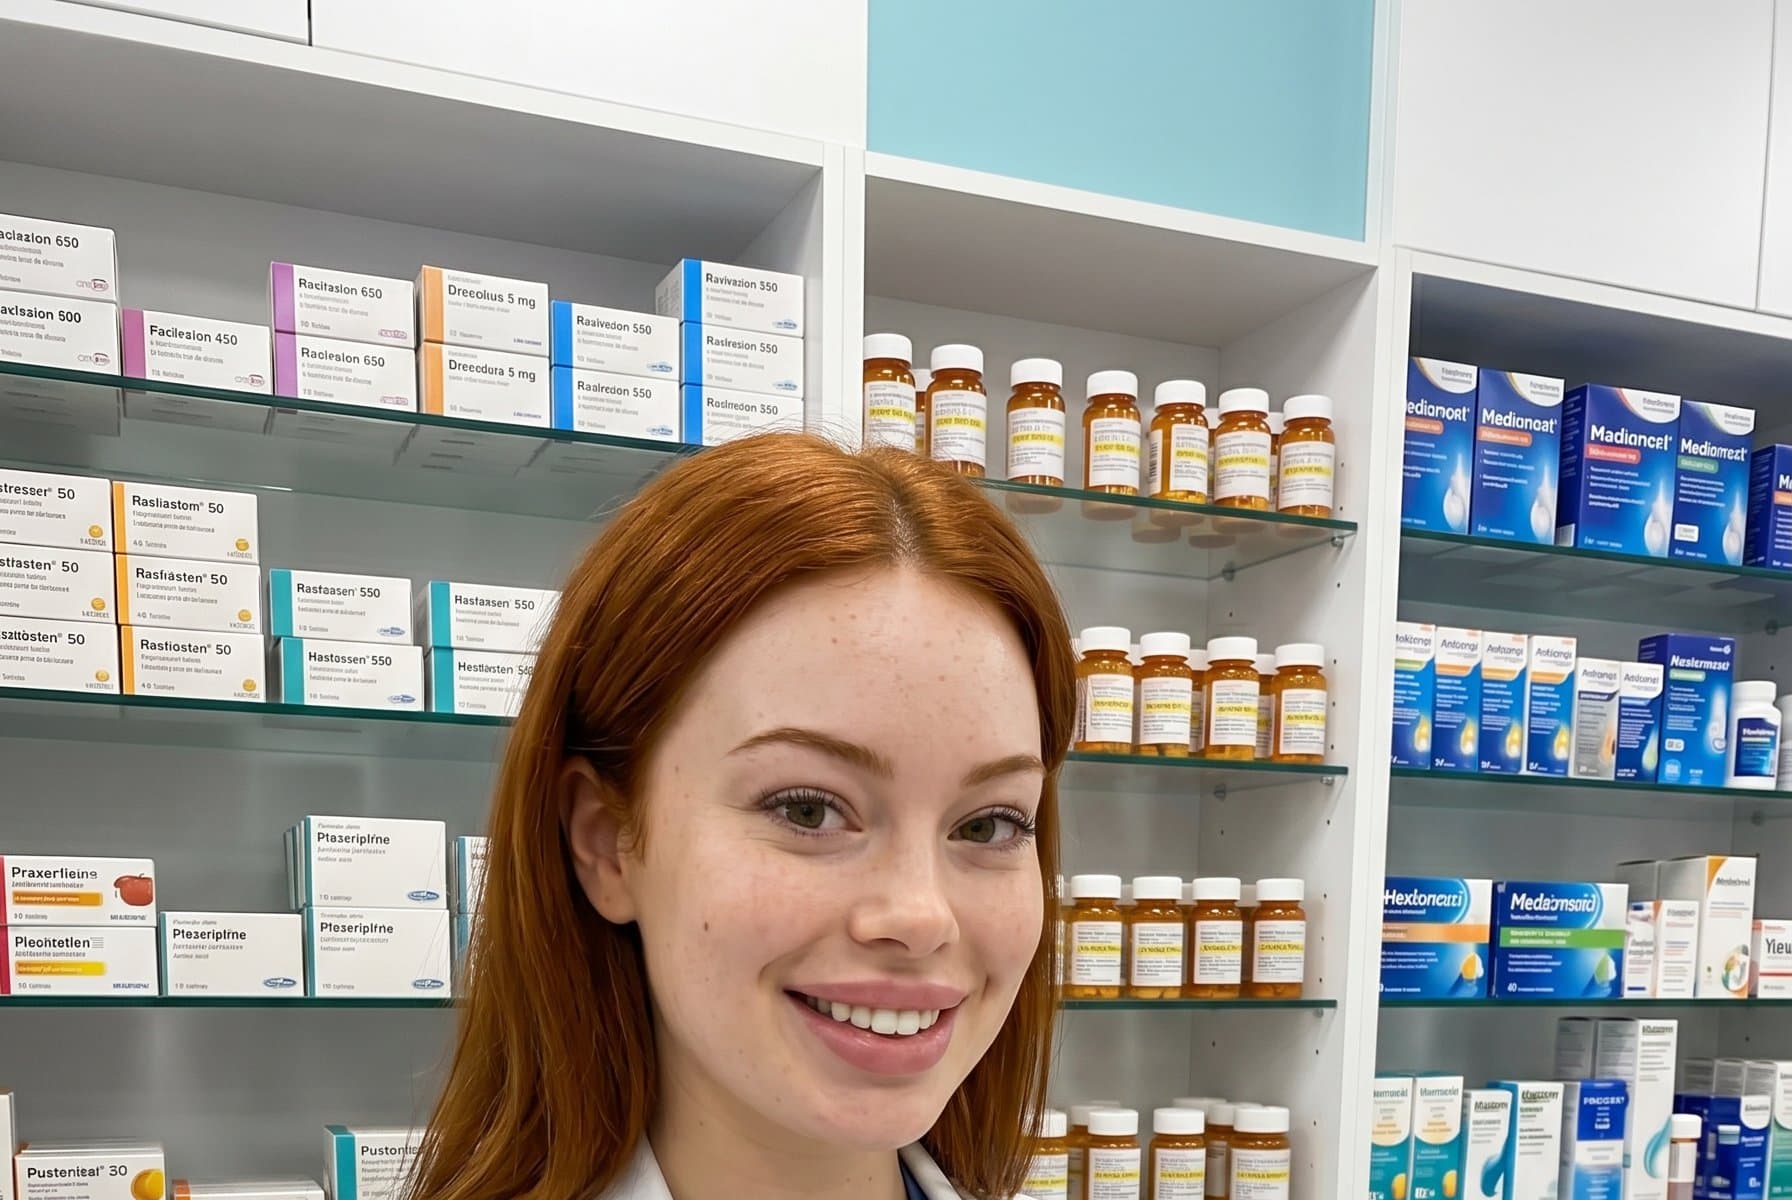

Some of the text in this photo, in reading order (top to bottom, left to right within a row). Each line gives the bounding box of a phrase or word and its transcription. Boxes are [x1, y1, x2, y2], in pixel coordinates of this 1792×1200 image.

[55, 235, 79, 248] 650
[361, 286, 383, 299] 650
[507, 293, 515, 304] 5
[518, 296, 536, 309] mg
[633, 323, 652, 335] 550
[215, 334, 238, 346] 450
[364, 354, 385, 367] 650
[508, 367, 515, 378] 5
[518, 370, 536, 383] mg
[633, 387, 652, 399] 550
[57, 488, 75, 500] 50
[208, 502, 224, 514] 50
[61, 561, 79, 573] 50
[210, 574, 228, 586] 50
[360, 587, 381, 599] 550
[514, 599, 535, 611] 550
[67, 634, 85, 646] 50
[215, 645, 232, 656] 50
[371, 656, 392, 667] 550
[109, 1165, 128, 1177] 30
